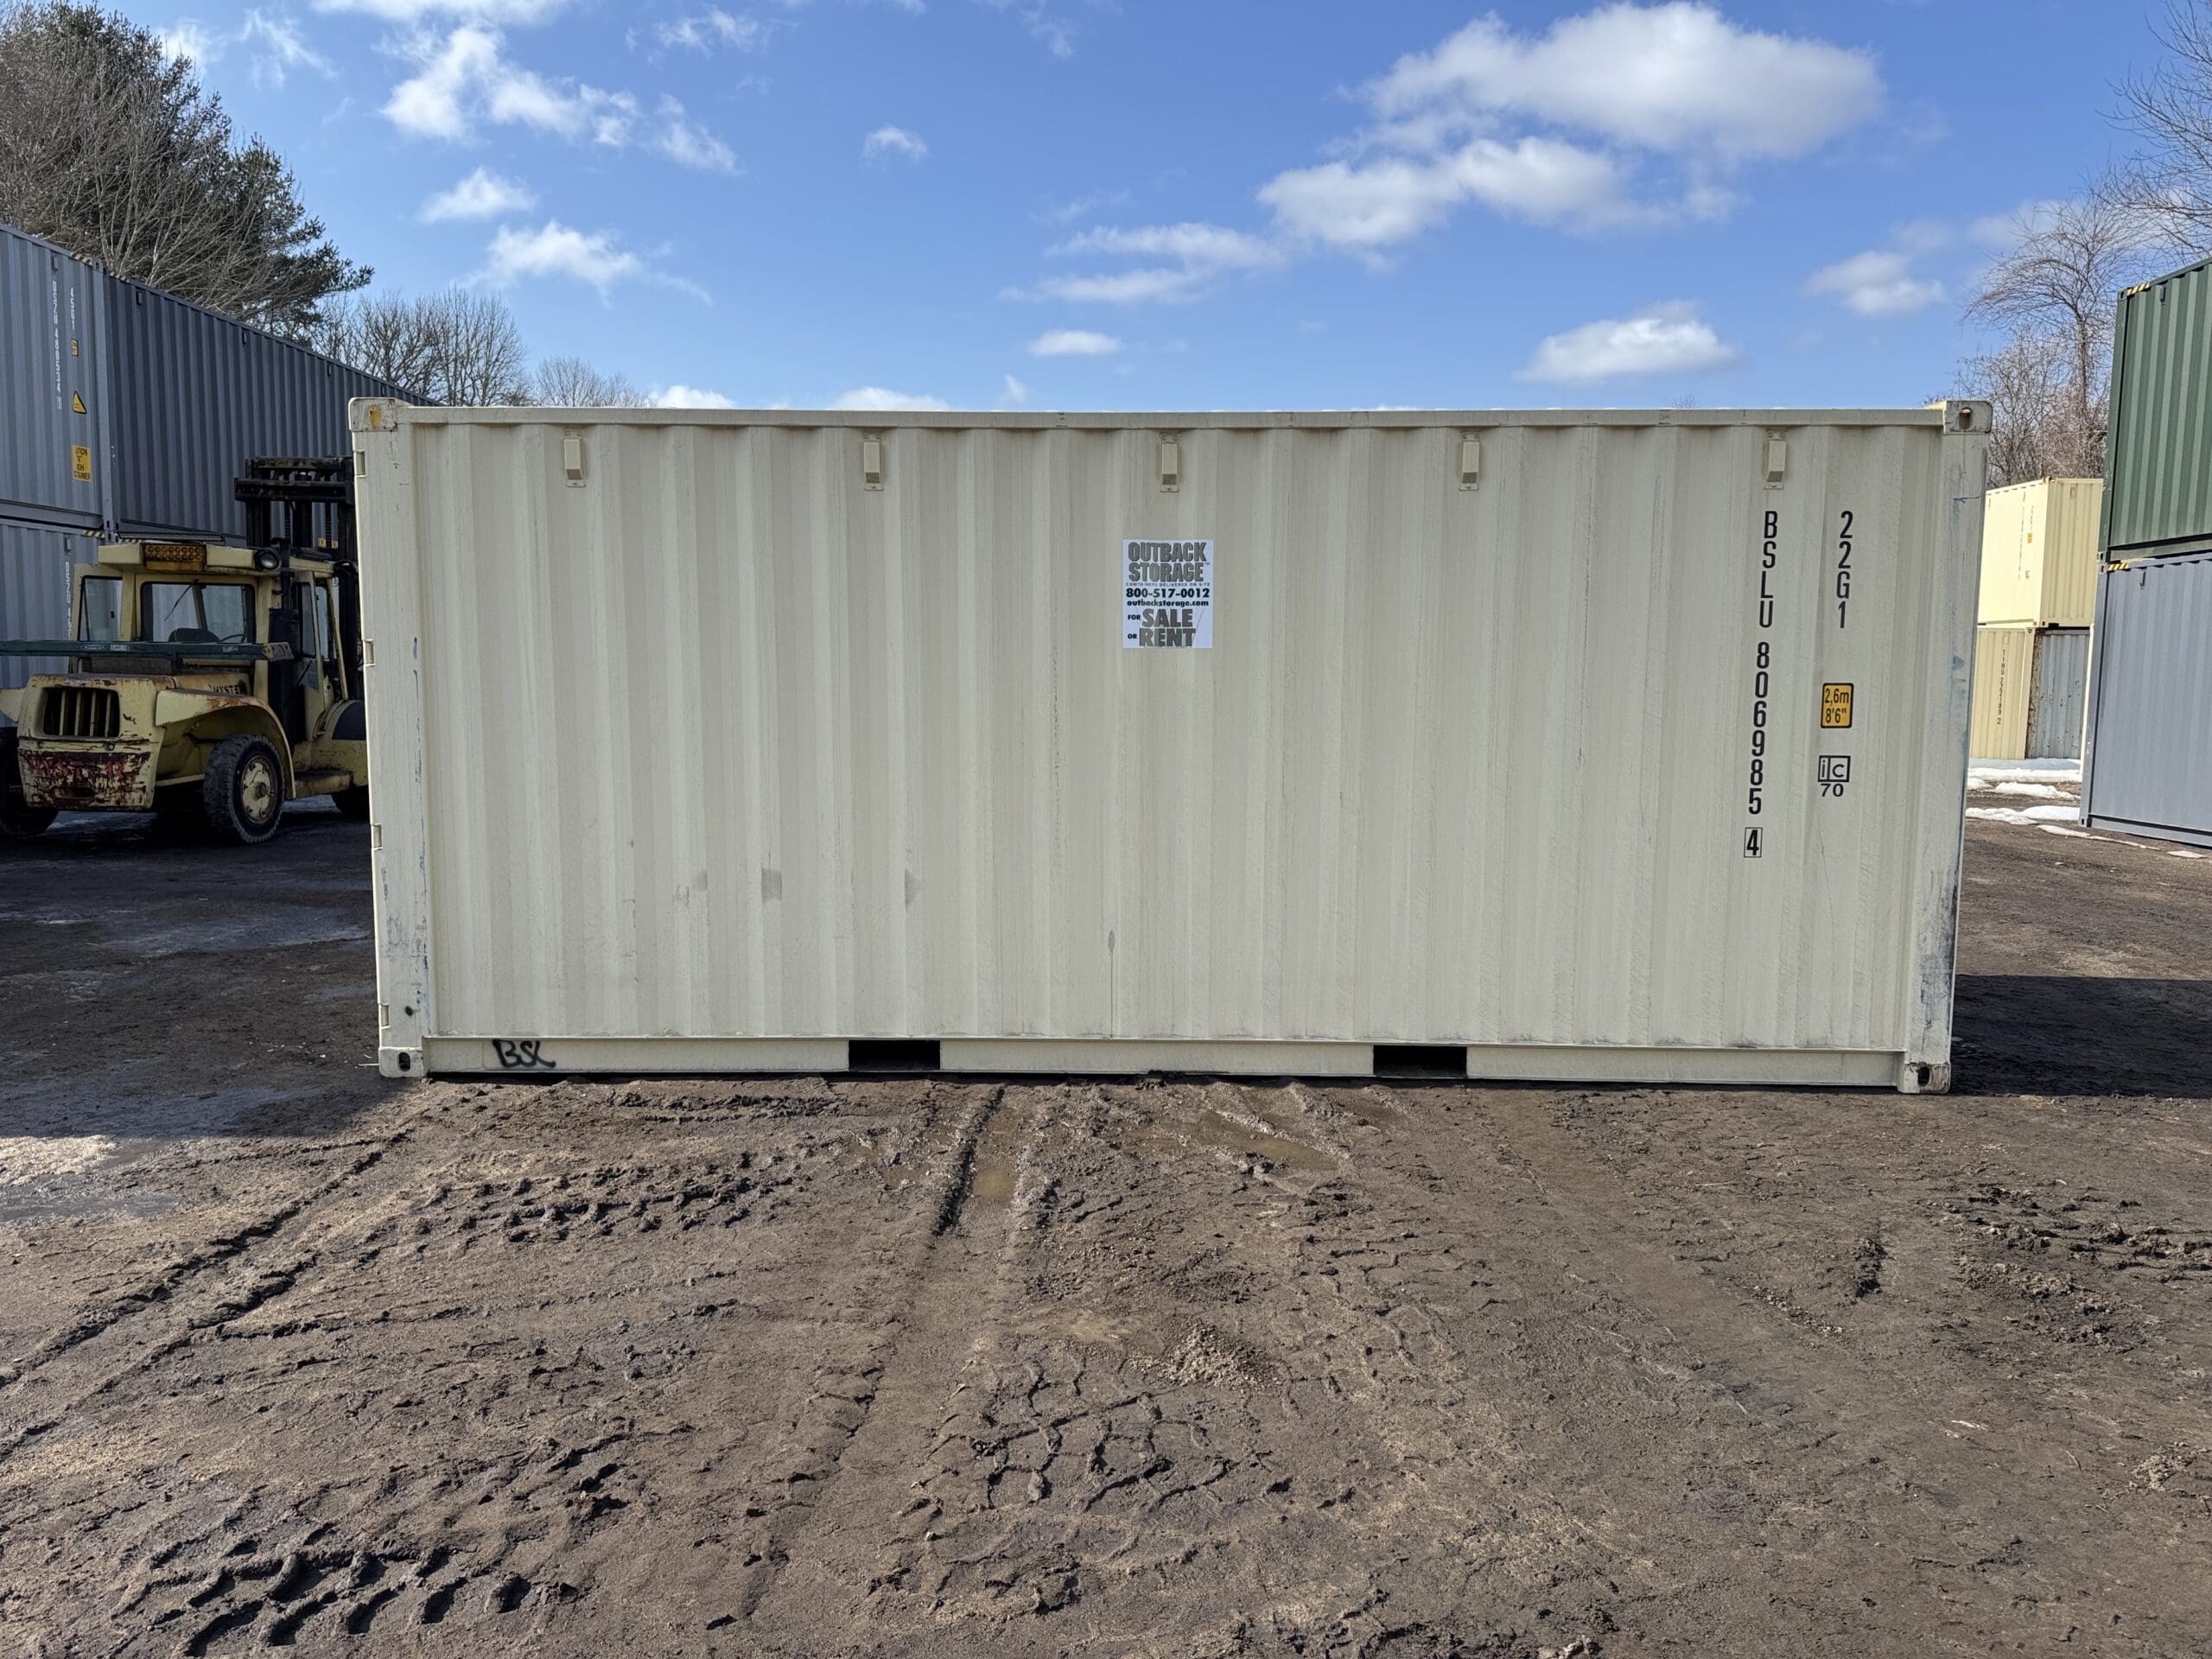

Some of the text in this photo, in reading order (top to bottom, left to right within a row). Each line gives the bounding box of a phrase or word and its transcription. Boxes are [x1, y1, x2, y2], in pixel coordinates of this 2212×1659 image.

[1128, 542, 1207, 563] OUTBACK
[1128, 563, 1205, 582] STORAGE
[1836, 511, 1853, 629] 22G1
[1126, 588, 1211, 598] 800-517-0012
[1127, 599, 1209, 607] outbackstorage.com
[1142, 608, 1193, 627] SALE
[1139, 627, 1196, 646] RENT
[1746, 511, 1778, 857] BSLU 806985 4
[1824, 688, 1850, 706] 2,6m
[1825, 708, 1847, 723] 8'6"
[1820, 783, 1845, 798] 70
